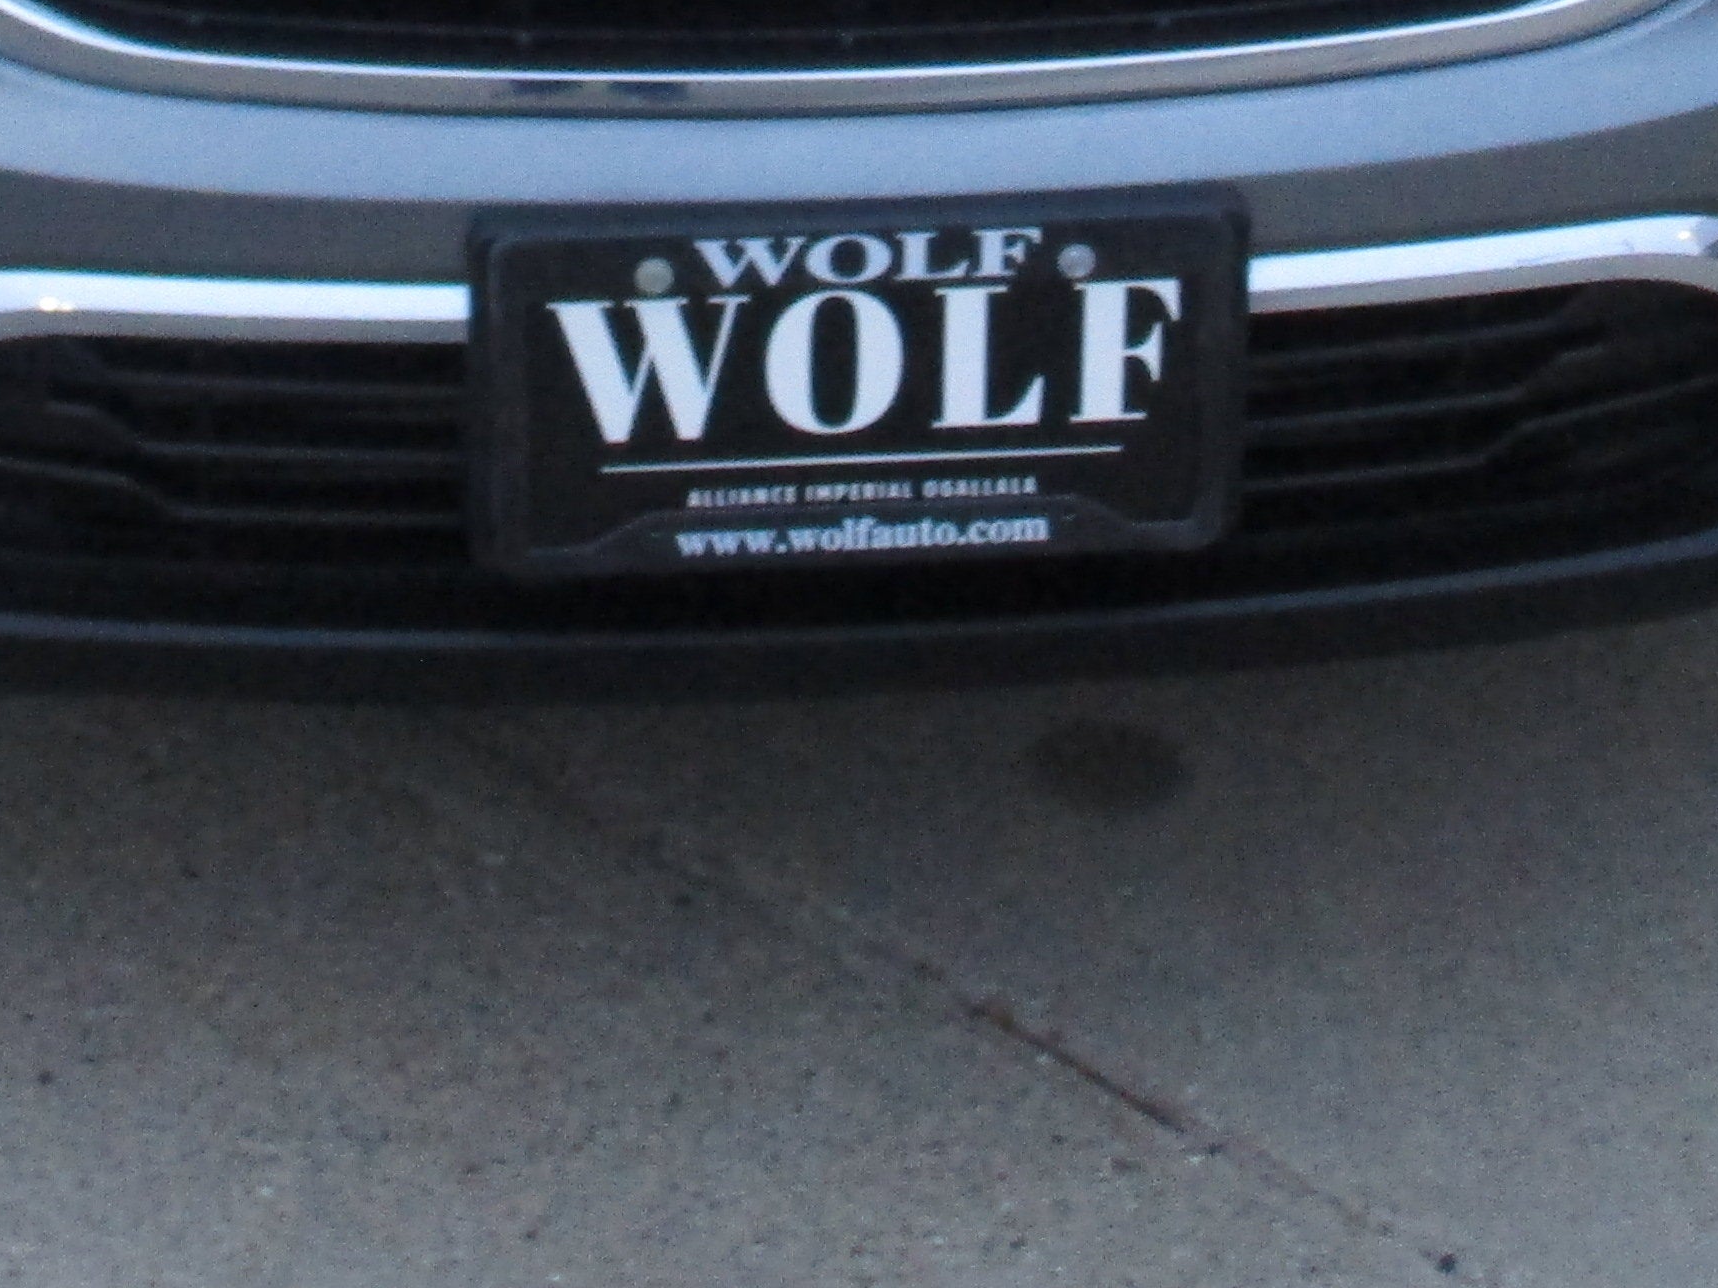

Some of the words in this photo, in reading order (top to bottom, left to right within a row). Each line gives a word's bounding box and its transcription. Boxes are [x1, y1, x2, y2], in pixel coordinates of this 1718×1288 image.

[694, 226, 1043, 289] WOLF
[546, 278, 1182, 444] WOLF
[675, 515, 1050, 557] www.wolfauto.com
